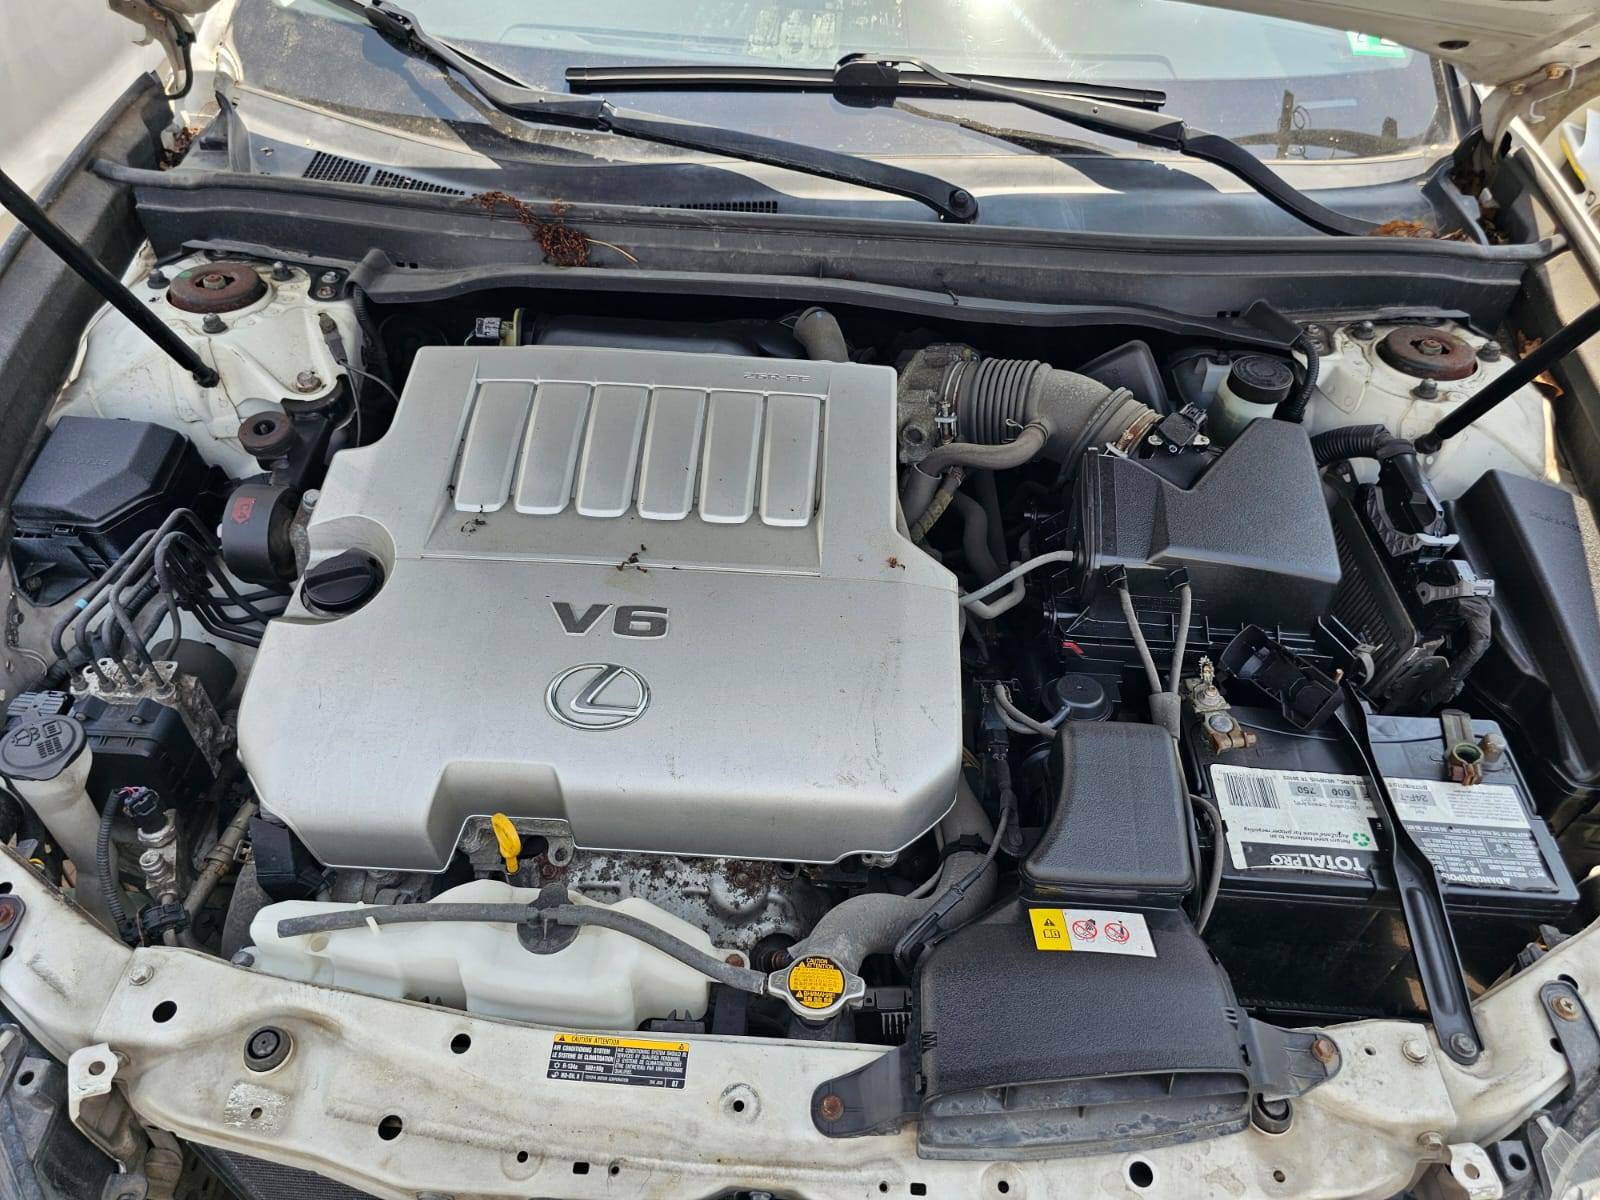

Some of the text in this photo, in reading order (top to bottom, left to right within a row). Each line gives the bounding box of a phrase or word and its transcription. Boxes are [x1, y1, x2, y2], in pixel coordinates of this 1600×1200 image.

[550, 602, 670, 640] V6
[1297, 786, 1316, 795] 750
[1331, 788, 1351, 797] 600
[1270, 853, 1366, 872] TOTALPRO
[594, 1037, 619, 1046] ATTENTION
